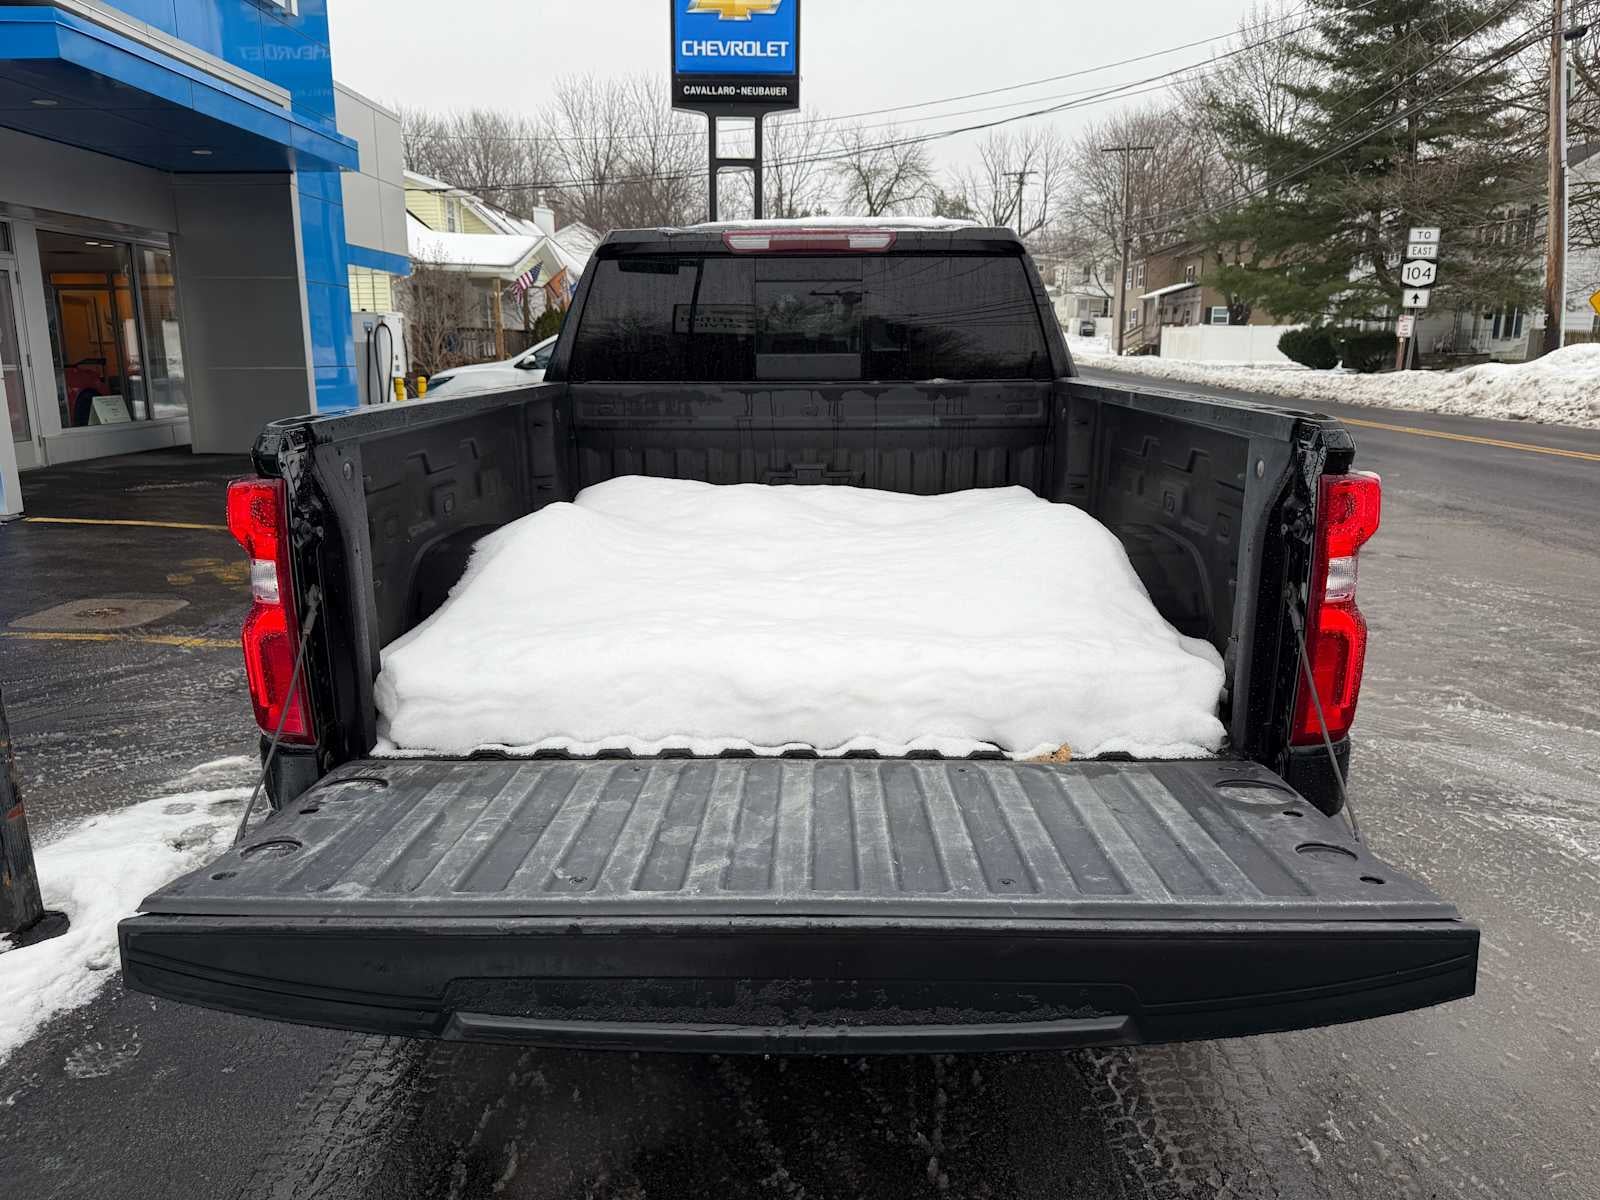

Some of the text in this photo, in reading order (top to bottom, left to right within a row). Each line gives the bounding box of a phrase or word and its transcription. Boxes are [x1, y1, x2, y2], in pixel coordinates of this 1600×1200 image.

[681, 40, 789, 57] CHEVROLET
[683, 85, 788, 96] CAVALLARO-NEUBAUER
[1418, 231, 1432, 240] TO
[1412, 246, 1433, 256] EAST
[1406, 266, 1432, 280] 104
